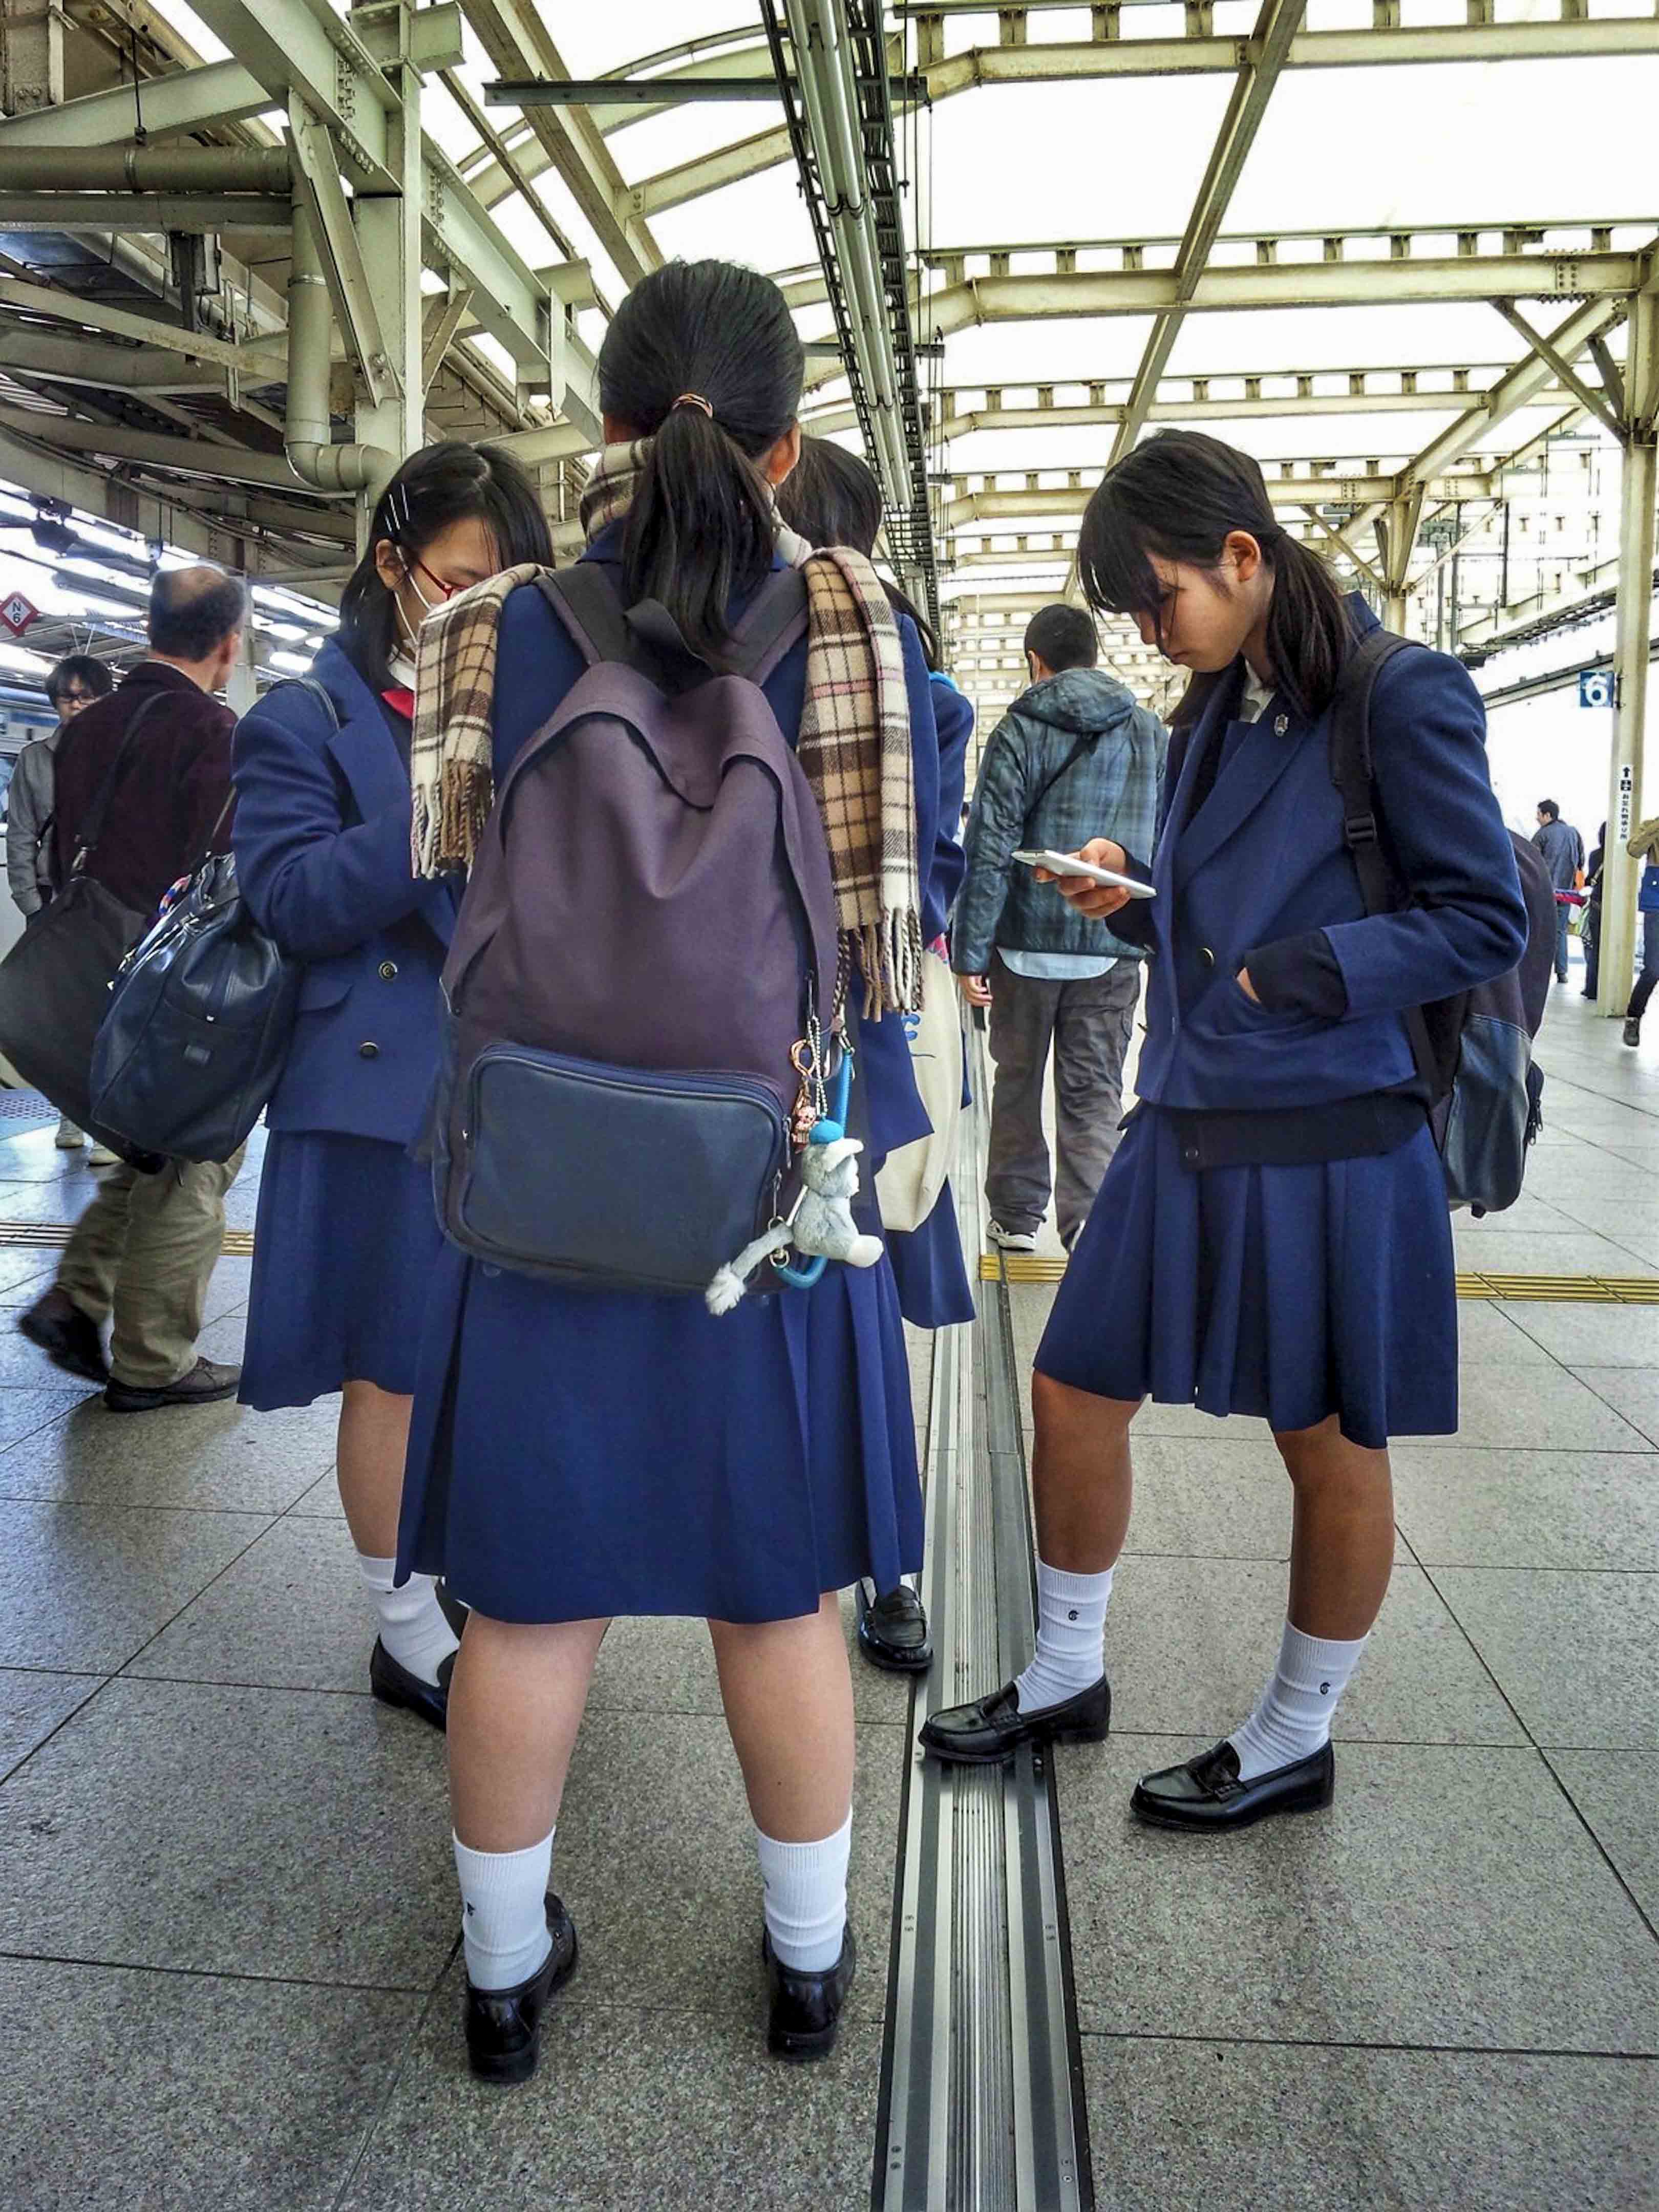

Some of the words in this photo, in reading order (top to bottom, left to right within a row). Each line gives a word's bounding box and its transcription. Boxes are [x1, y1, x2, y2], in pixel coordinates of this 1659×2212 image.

[12, 602, 21, 611] N
[13, 613, 20, 623] 6
[1585, 674, 1608, 706] 6
